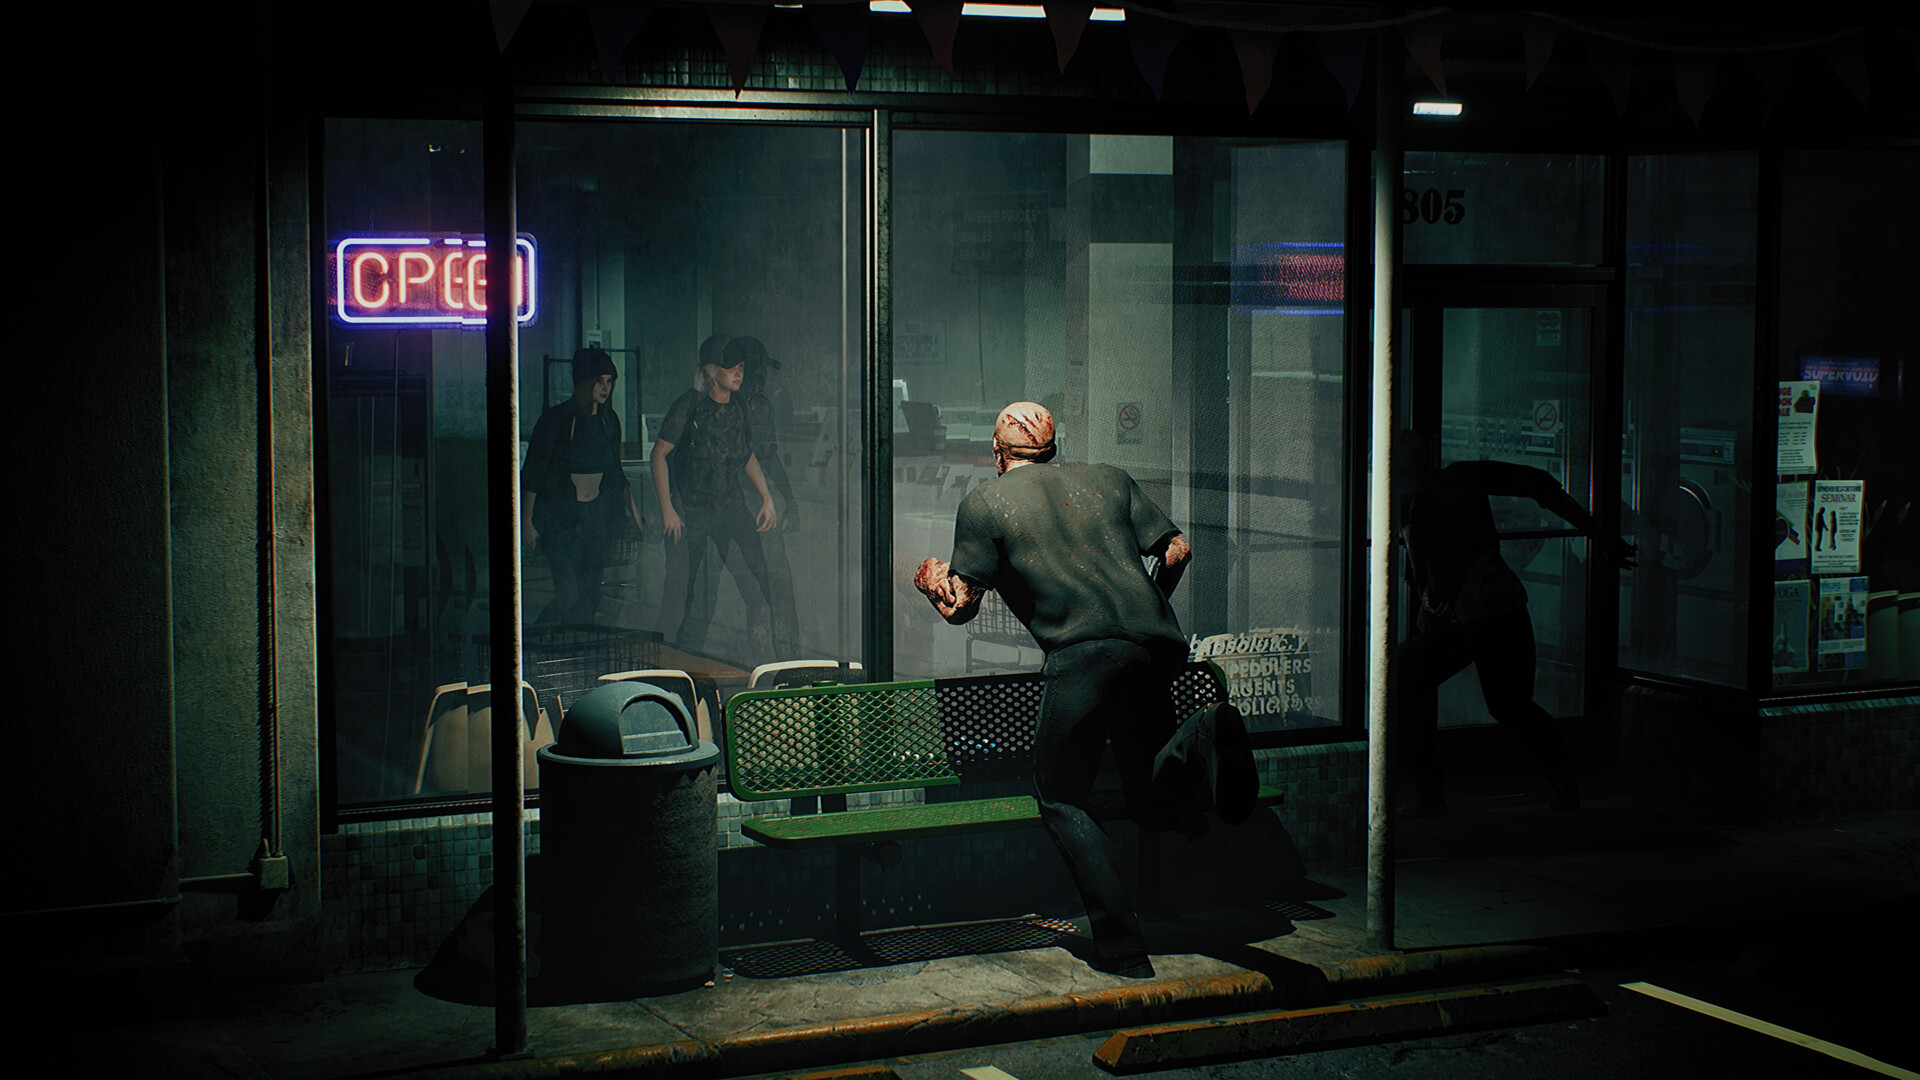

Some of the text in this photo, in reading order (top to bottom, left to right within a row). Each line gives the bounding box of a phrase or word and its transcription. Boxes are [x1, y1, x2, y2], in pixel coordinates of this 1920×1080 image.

[1401, 188, 1466, 225] 805
[353, 251, 524, 311] OPE
[895, 335, 940, 345] SPONSIBLE
[1820, 493, 1857, 503] SEMINAR
